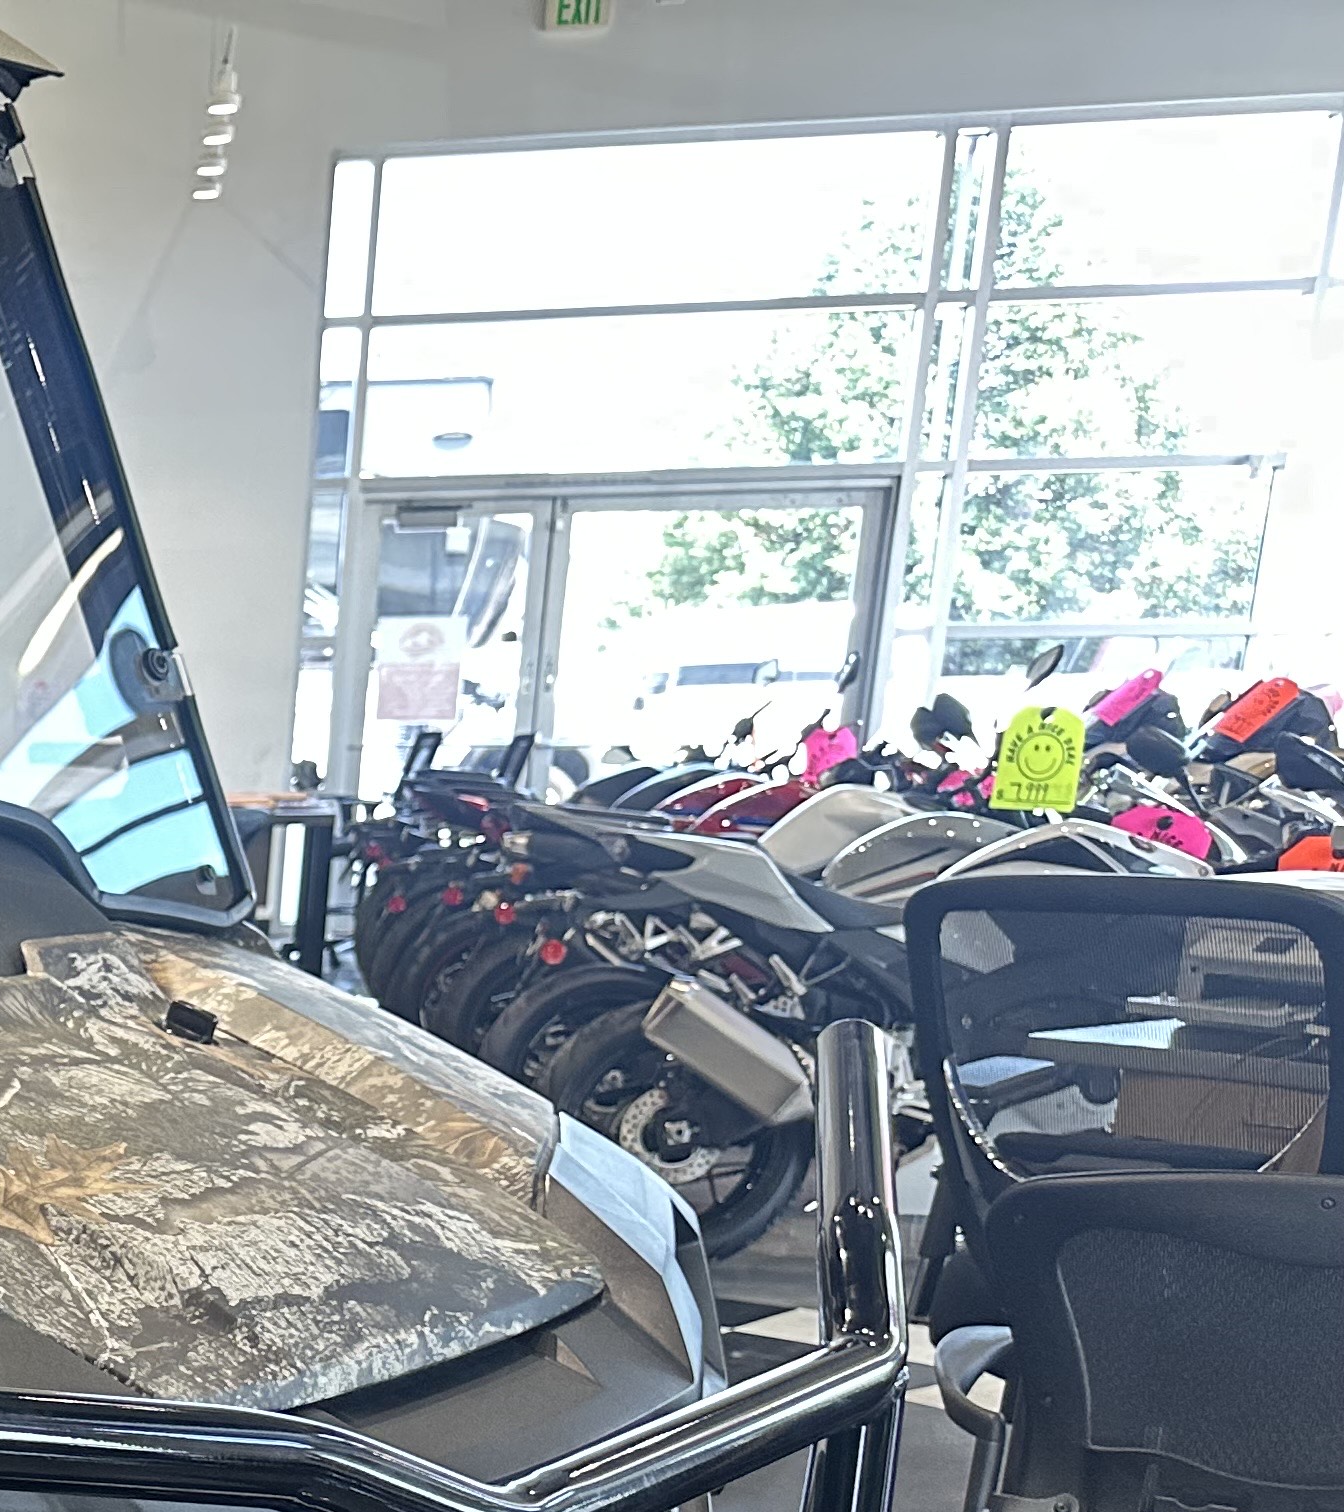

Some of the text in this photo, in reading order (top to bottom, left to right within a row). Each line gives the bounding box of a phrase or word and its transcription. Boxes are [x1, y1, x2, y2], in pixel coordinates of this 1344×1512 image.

[556, 0, 600, 25] EXIT
[1005, 732, 1024, 763] HAVE
[1038, 722, 1065, 737] NICE
